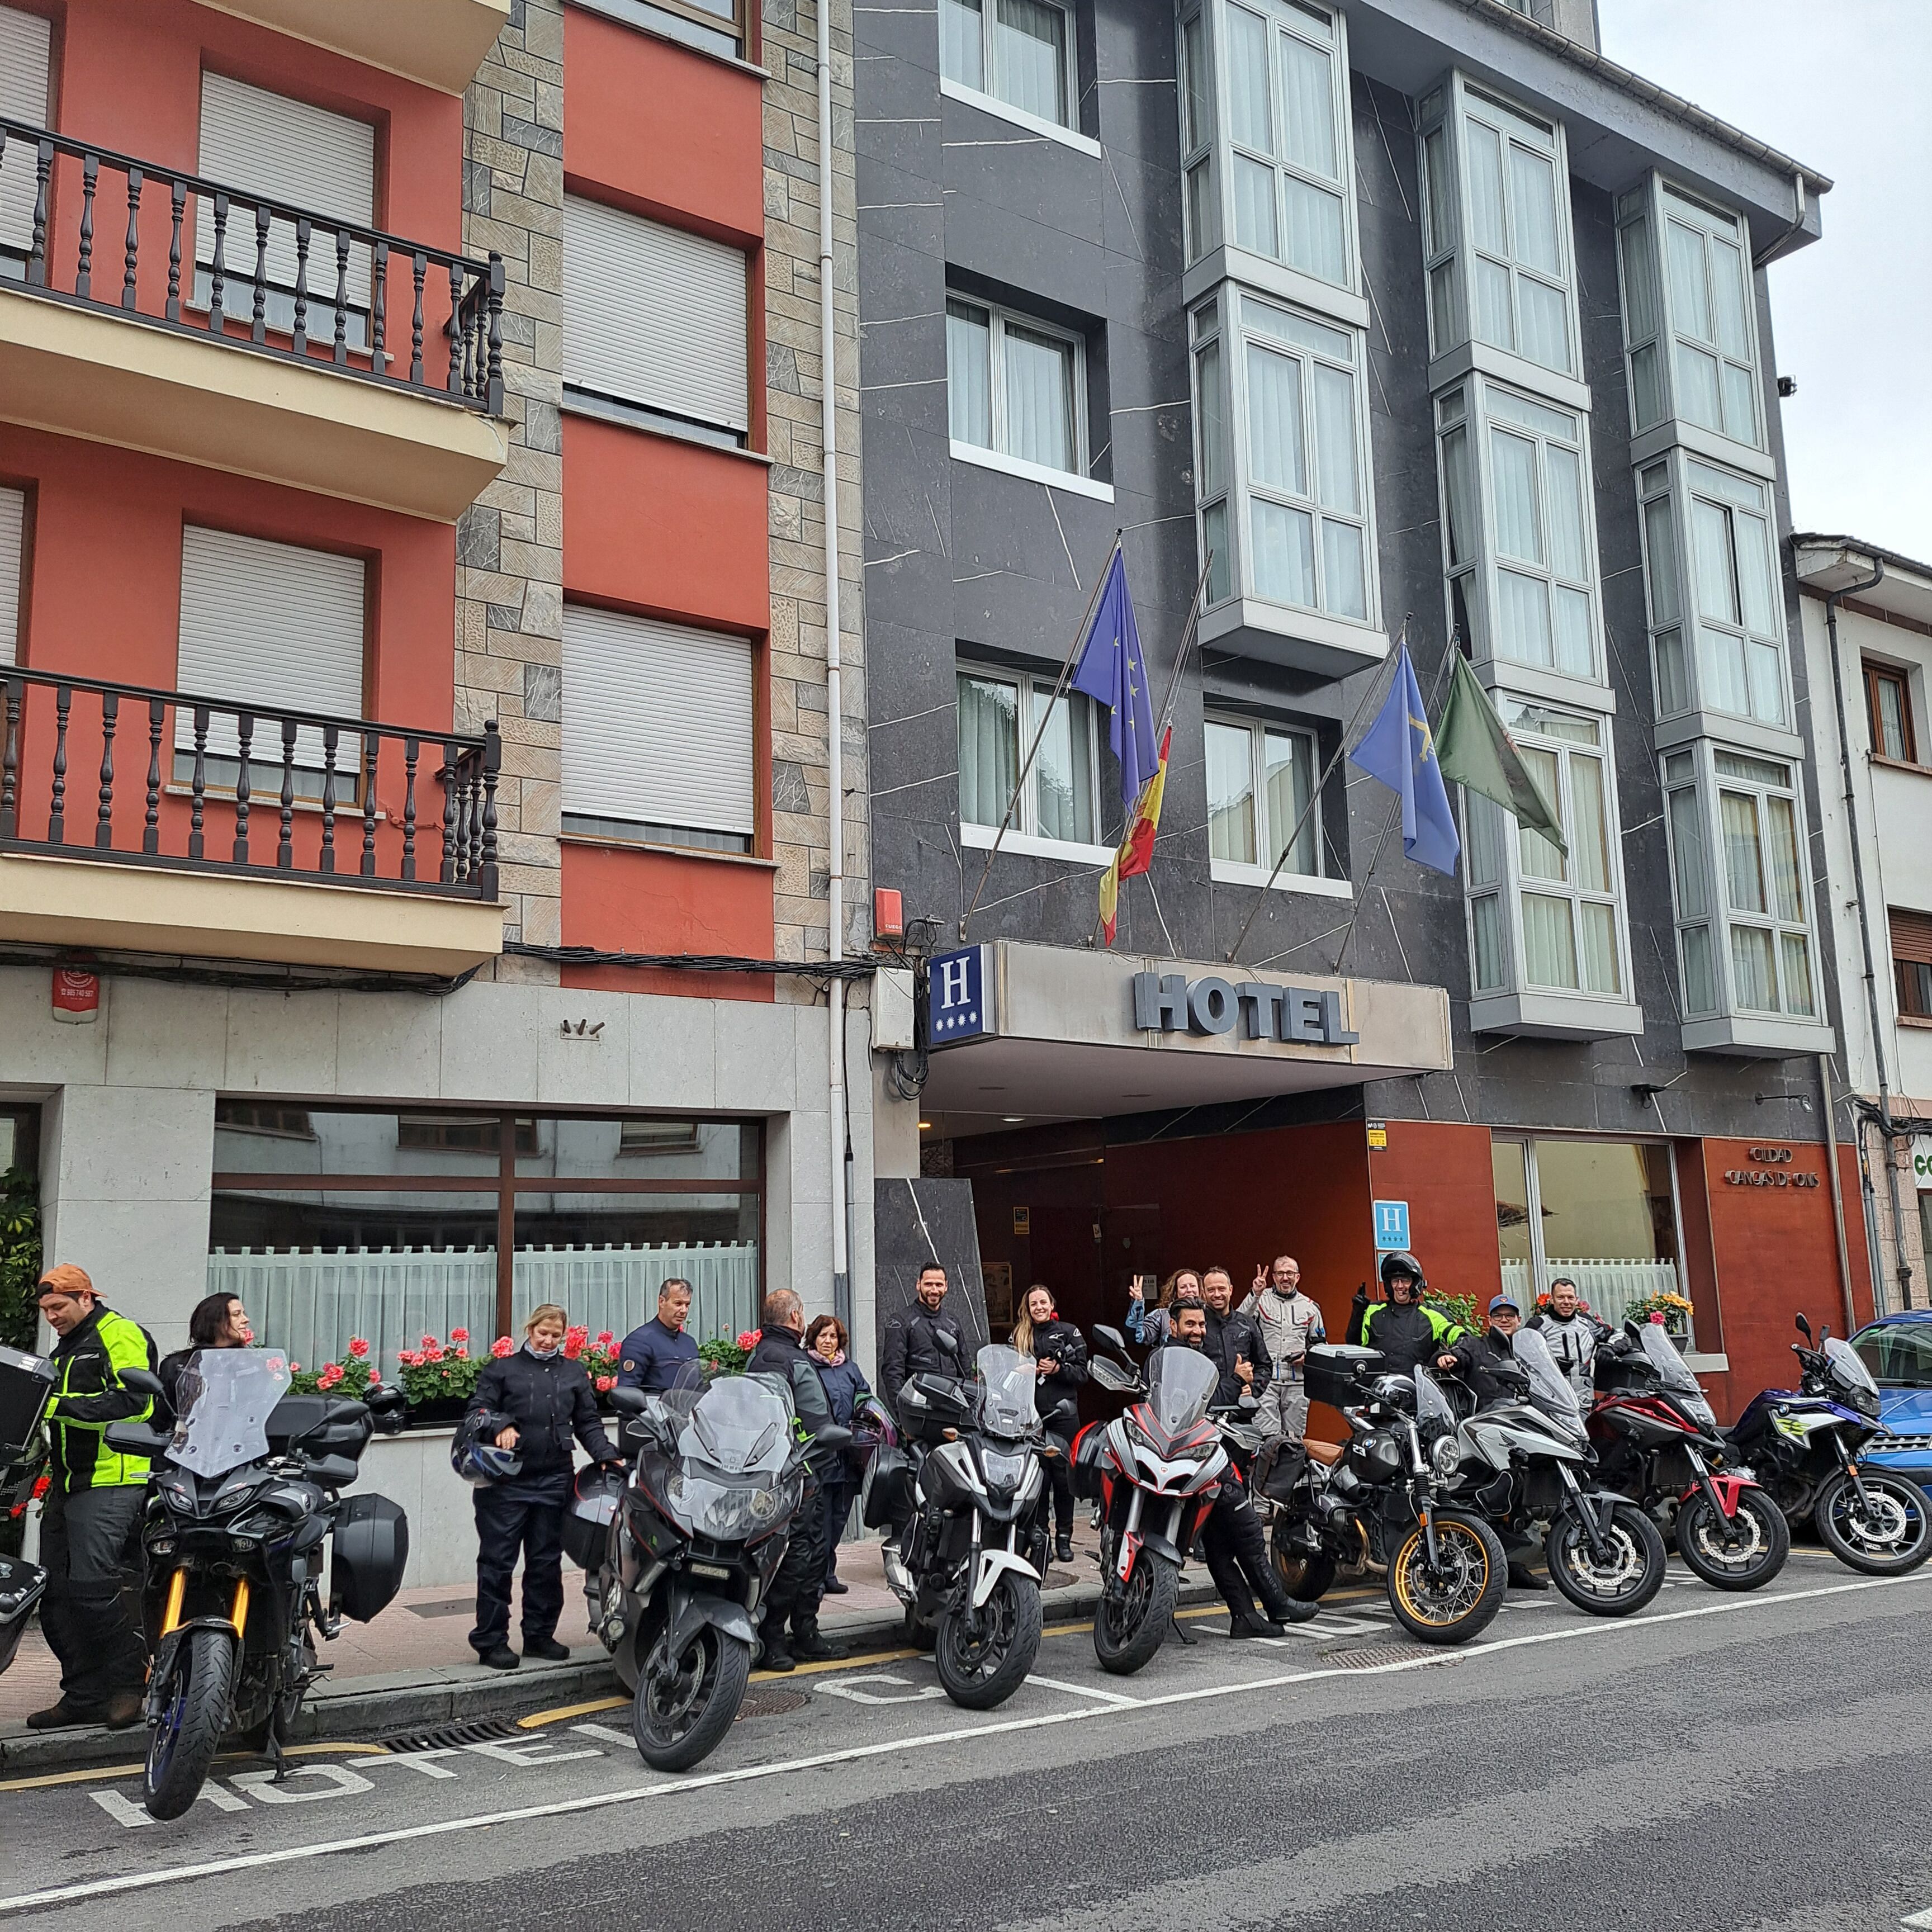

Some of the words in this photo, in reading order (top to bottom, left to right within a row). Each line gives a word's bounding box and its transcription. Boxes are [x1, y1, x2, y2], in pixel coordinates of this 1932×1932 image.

[940, 956, 972, 1009] H
[1134, 972, 1360, 1045] HOTEL
[1750, 1147, 1793, 1162] CIUDAD
[1725, 1169, 1774, 1186] CANGAS
[1775, 1171, 1792, 1186] DE
[1381, 1208, 1403, 1232] H
[1353, 1444, 1366, 1457] 23
